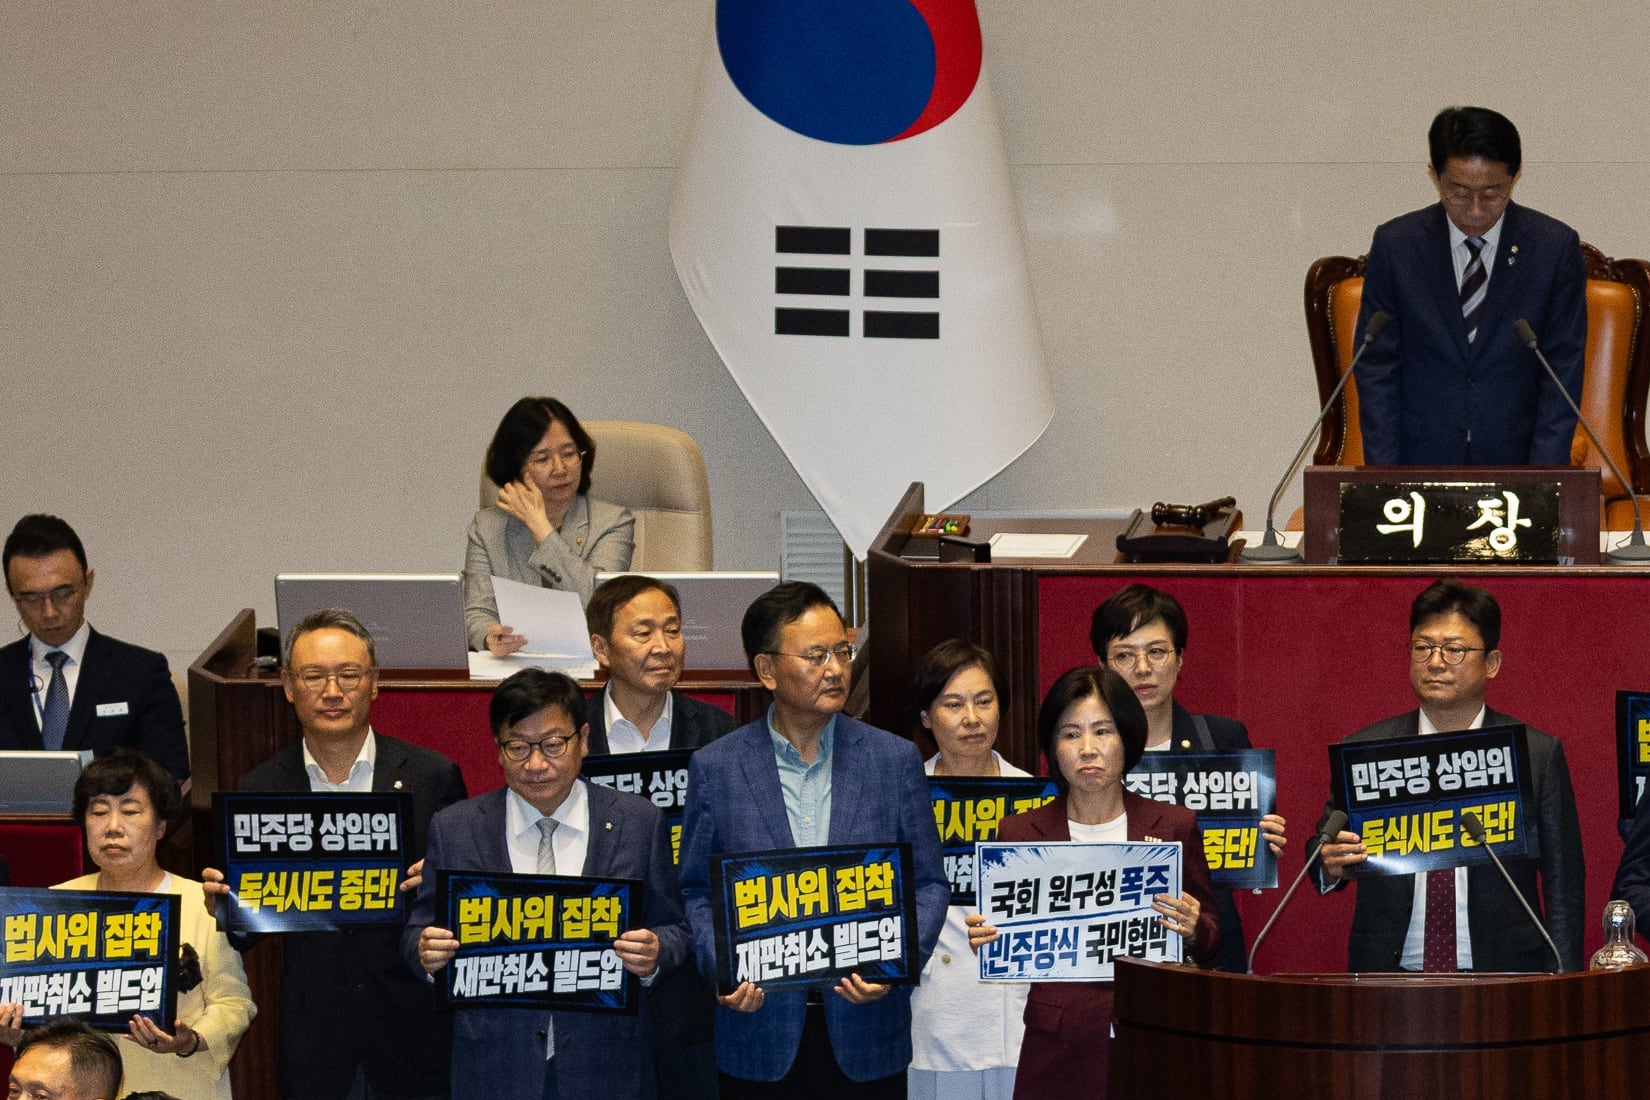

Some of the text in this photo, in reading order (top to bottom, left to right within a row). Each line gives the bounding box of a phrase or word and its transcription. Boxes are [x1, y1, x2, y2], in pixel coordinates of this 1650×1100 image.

[1376, 490, 1532, 551] 의장
[1125, 771, 1258, 811] 주당 상임위
[1351, 747, 1514, 802] 민주당 상임위
[234, 811, 398, 852] 민주당 상임위
[1202, 827, 1258, 870] 중단!
[1361, 815, 1455, 859] 독식시도
[238, 867, 399, 913] 독식시도 중단!
[734, 866, 830, 929] 법사위
[834, 859, 894, 913] 집착
[991, 863, 1170, 919] 국회 원구성 폭주
[4, 909, 162, 962] 법사위 집착
[458, 894, 622, 944] 법사위 집착
[736, 915, 901, 982] 재판취소 빌드업
[988, 917, 1168, 977] 민주당식 국민협박
[0, 967, 163, 1017] 재판취소 빌드업
[453, 948, 623, 998] 재판취소 빌드업
